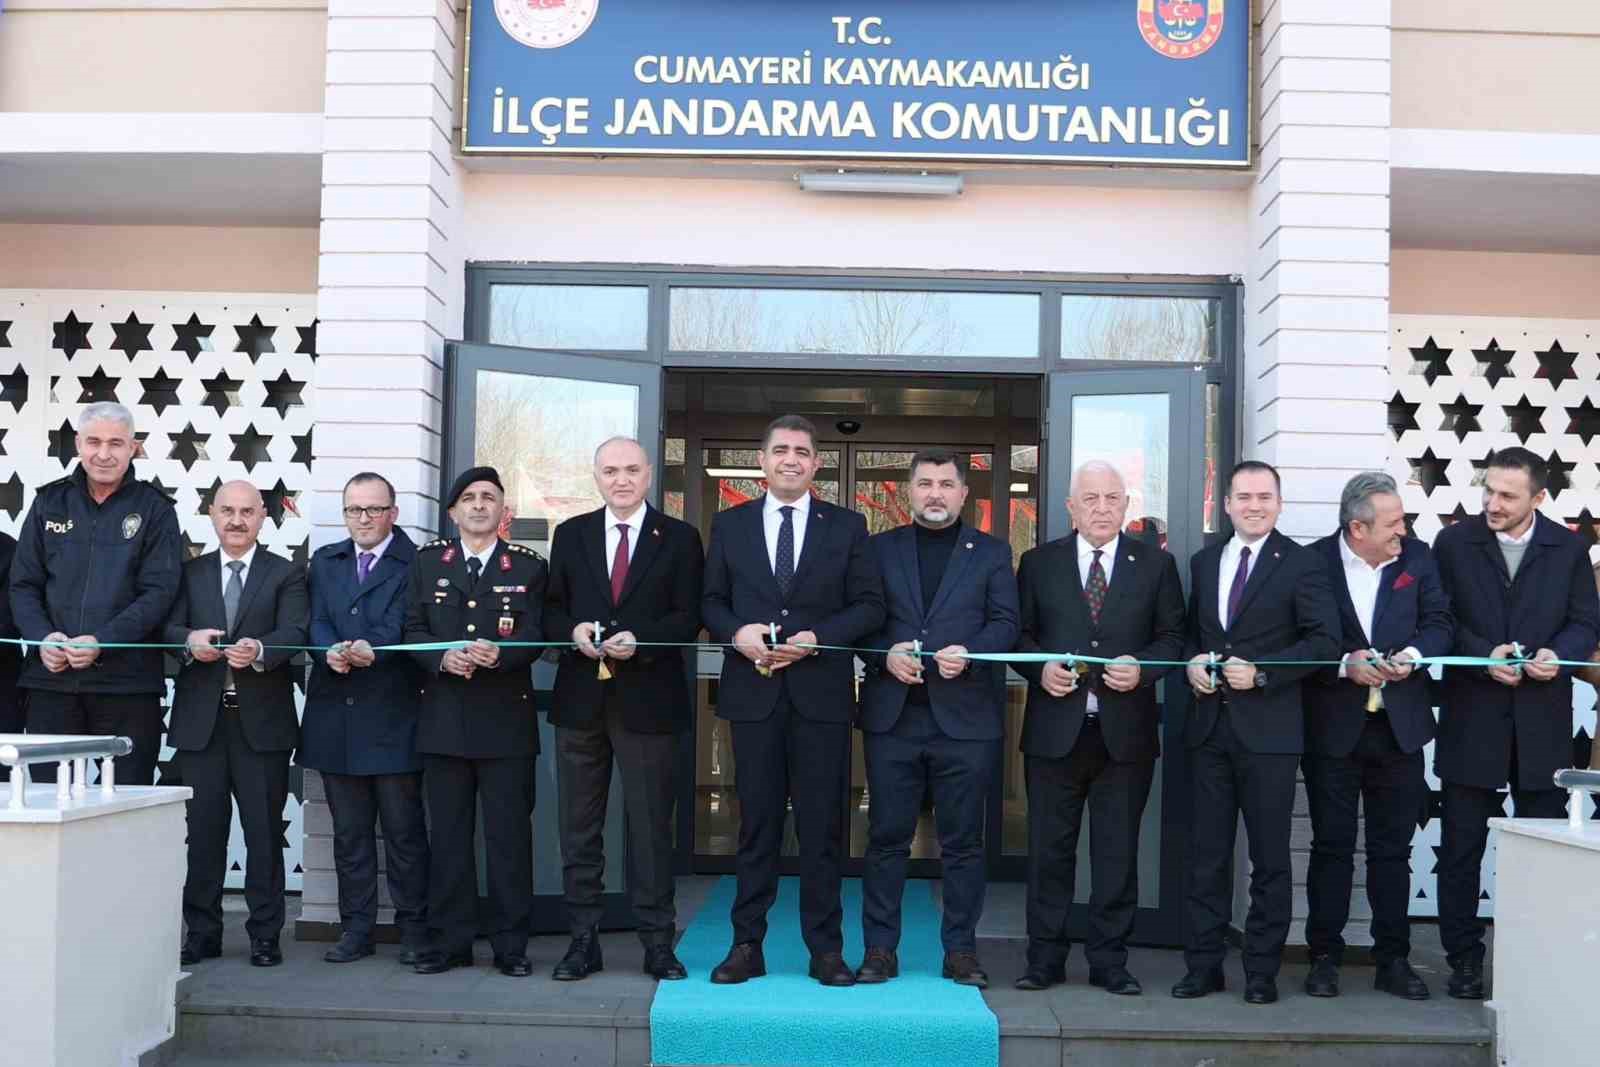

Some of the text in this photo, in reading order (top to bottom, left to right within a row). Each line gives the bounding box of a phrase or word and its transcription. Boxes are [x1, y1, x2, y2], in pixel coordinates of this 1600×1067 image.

[832, 16, 891, 45] T.C.
[634, 50, 1090, 90] CUMAYERİ KAYMAKAMLIĞI
[492, 87, 1230, 146] İLÇE JANDARMA KOMUTANLIĞI
[45, 520, 74, 533] POLS
